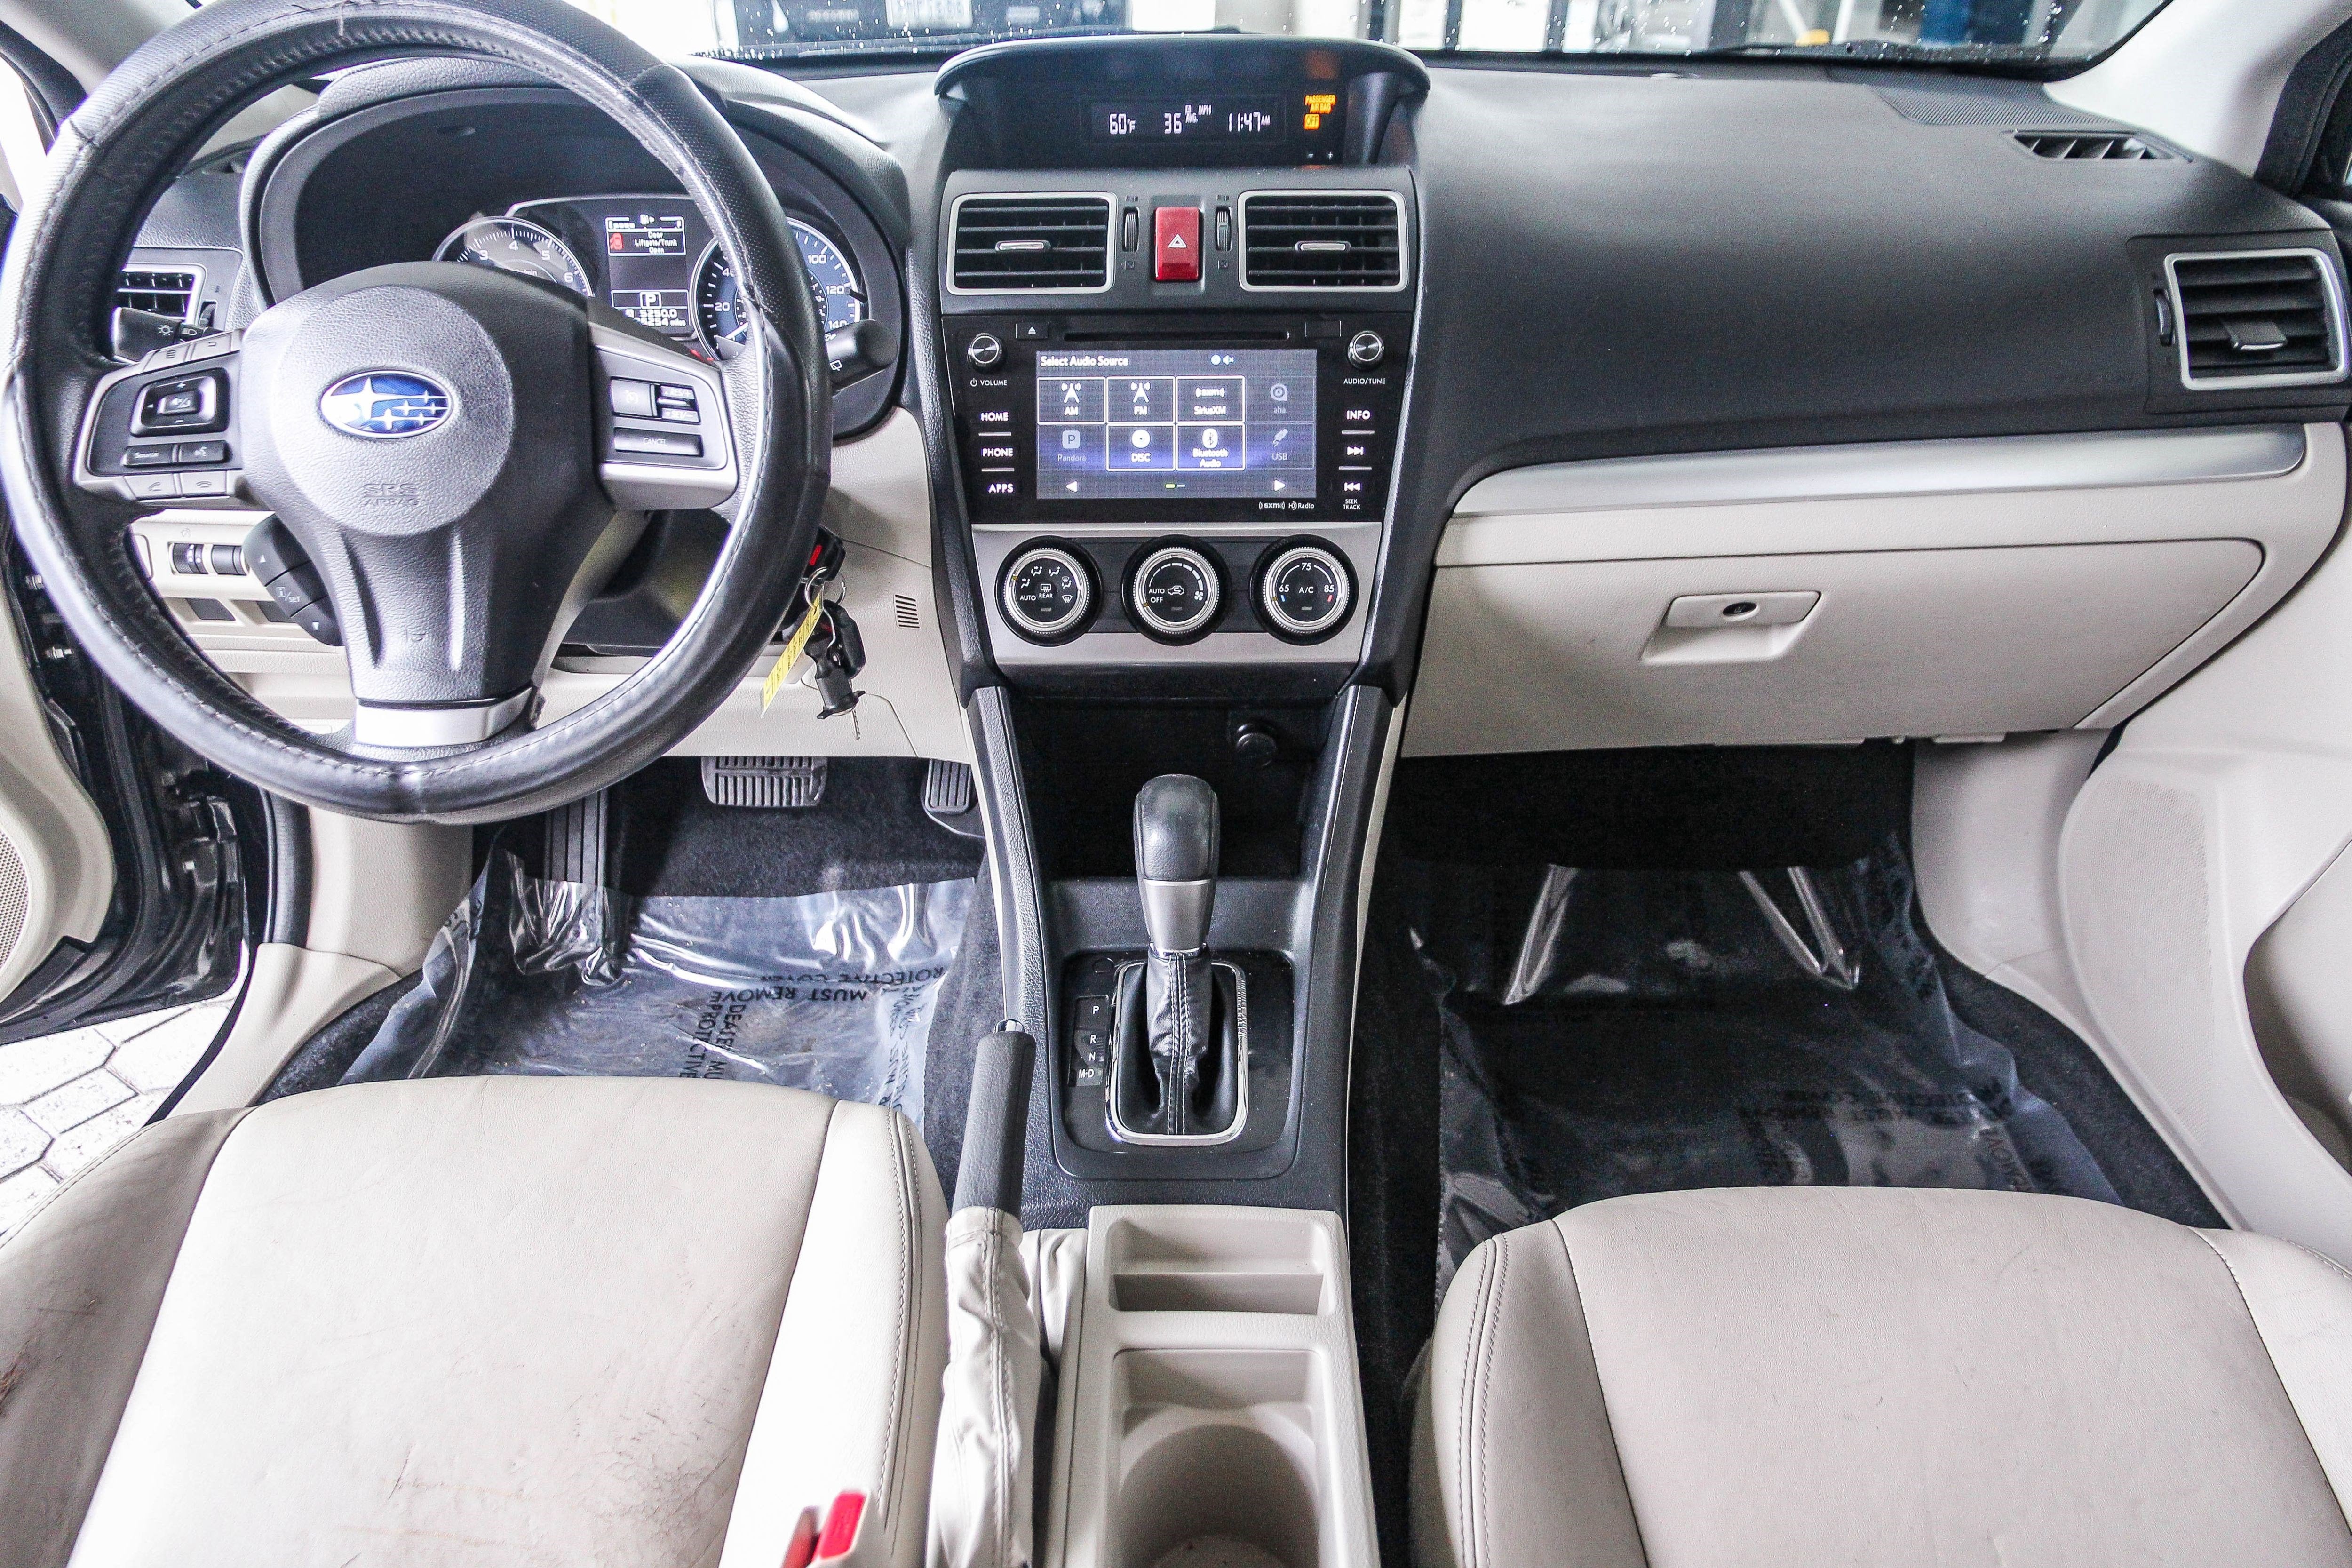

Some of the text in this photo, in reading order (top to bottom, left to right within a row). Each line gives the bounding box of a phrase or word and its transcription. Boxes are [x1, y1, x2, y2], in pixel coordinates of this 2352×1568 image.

[1305, 95, 1336, 105] PASSENGER
[1198, 104, 1212, 115] MPH
[1309, 103, 1332, 113] AIR BAG
[1164, 112, 1182, 134] 36
[1229, 111, 1271, 132] 11:47 AM
[1305, 114, 1319, 126] OFF
[509, 240, 518, 251] 4
[635, 239, 678, 247] Liftgate/Trunk
[479, 249, 489, 261] 3
[541, 250, 551, 261] 5
[807, 255, 827, 264] 100
[564, 271, 573, 283] 6
[826, 285, 845, 295] 120
[646, 293, 657, 307] P
[715, 302, 731, 312] 20
[1041, 355, 1129, 367] Select Audio Source
[1064, 406, 1079, 416] AM
[1134, 406, 1148, 415] FM
[1193, 405, 1227, 415] SiriusXM
[1273, 406, 1286, 414] aha
[1346, 410, 1371, 420] INFO
[980, 412, 1009, 422] HOME
[982, 448, 1014, 457] PHONE
[1131, 453, 1152, 462] DISC
[1192, 448, 1229, 458] Bluetooth
[1199, 459, 1222, 468] Audio
[363, 483, 417, 494] SRS
[988, 483, 1014, 493] APPS
[1301, 563, 1312, 571] 75
[1279, 584, 1289, 593] 65
[1324, 584, 1335, 593] 85
[710, 986, 867, 1002] MUST REMOVE
[1092, 1005, 1100, 1015] P
[1089, 1034, 1097, 1044] R
[1089, 1051, 1096, 1061] N
